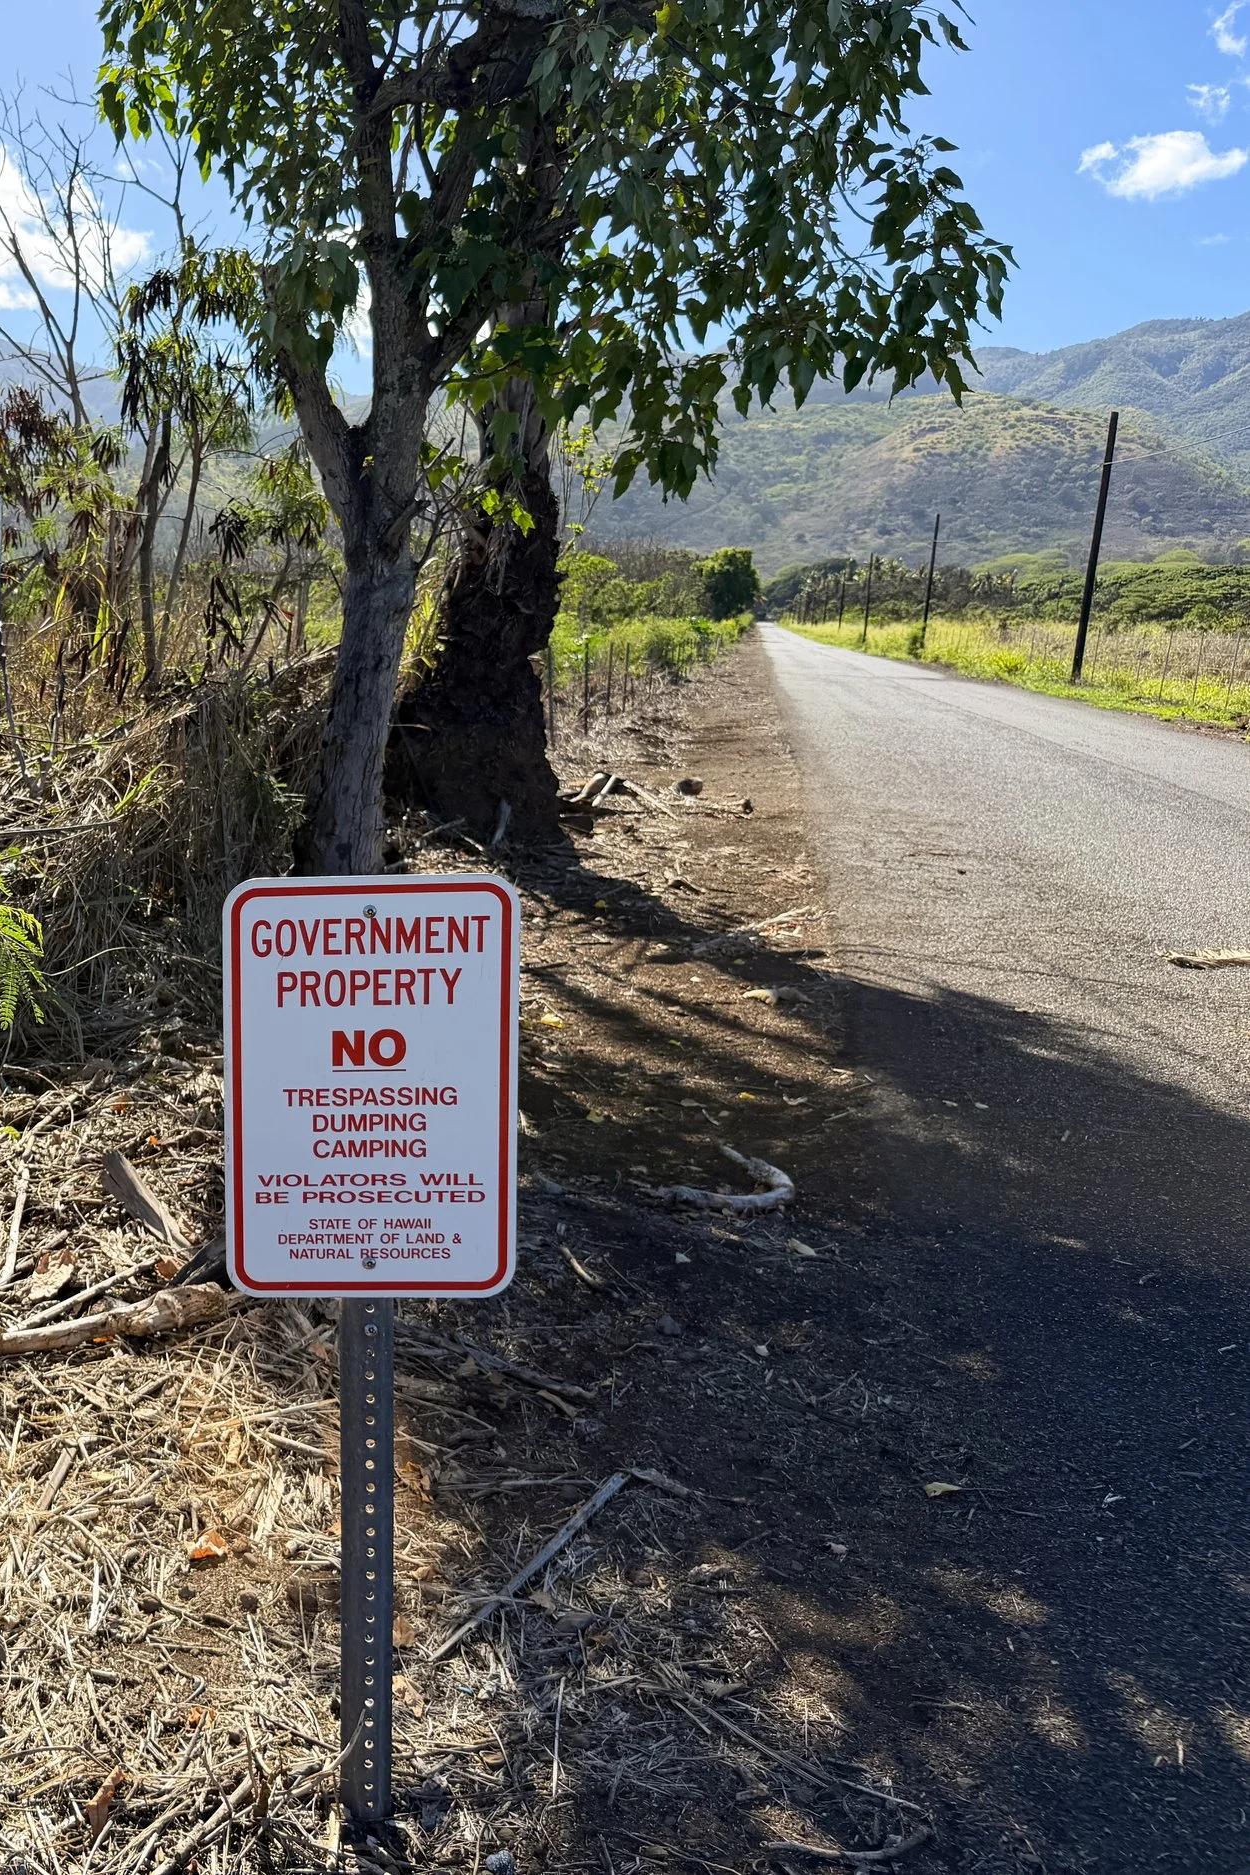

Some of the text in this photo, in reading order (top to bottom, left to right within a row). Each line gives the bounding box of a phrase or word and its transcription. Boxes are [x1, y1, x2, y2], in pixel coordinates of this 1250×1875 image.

[251, 915, 491, 958] GOVERNMENT
[276, 968, 462, 1008] PROPERTY
[332, 1028, 407, 1067] NO
[282, 1086, 458, 1108] TRESPASSING
[312, 1112, 427, 1132] DUMPING
[312, 1138, 427, 1158] CAMPING
[258, 1172, 484, 1187] VIOLATORS WILL
[254, 1190, 486, 1204] BE PROSECUTED
[308, 1218, 432, 1230] STATE OF HAWAII
[277, 1232, 462, 1246] DEPARTMENT OF LAND &
[288, 1248, 451, 1260] NATURAL RESOURCES
